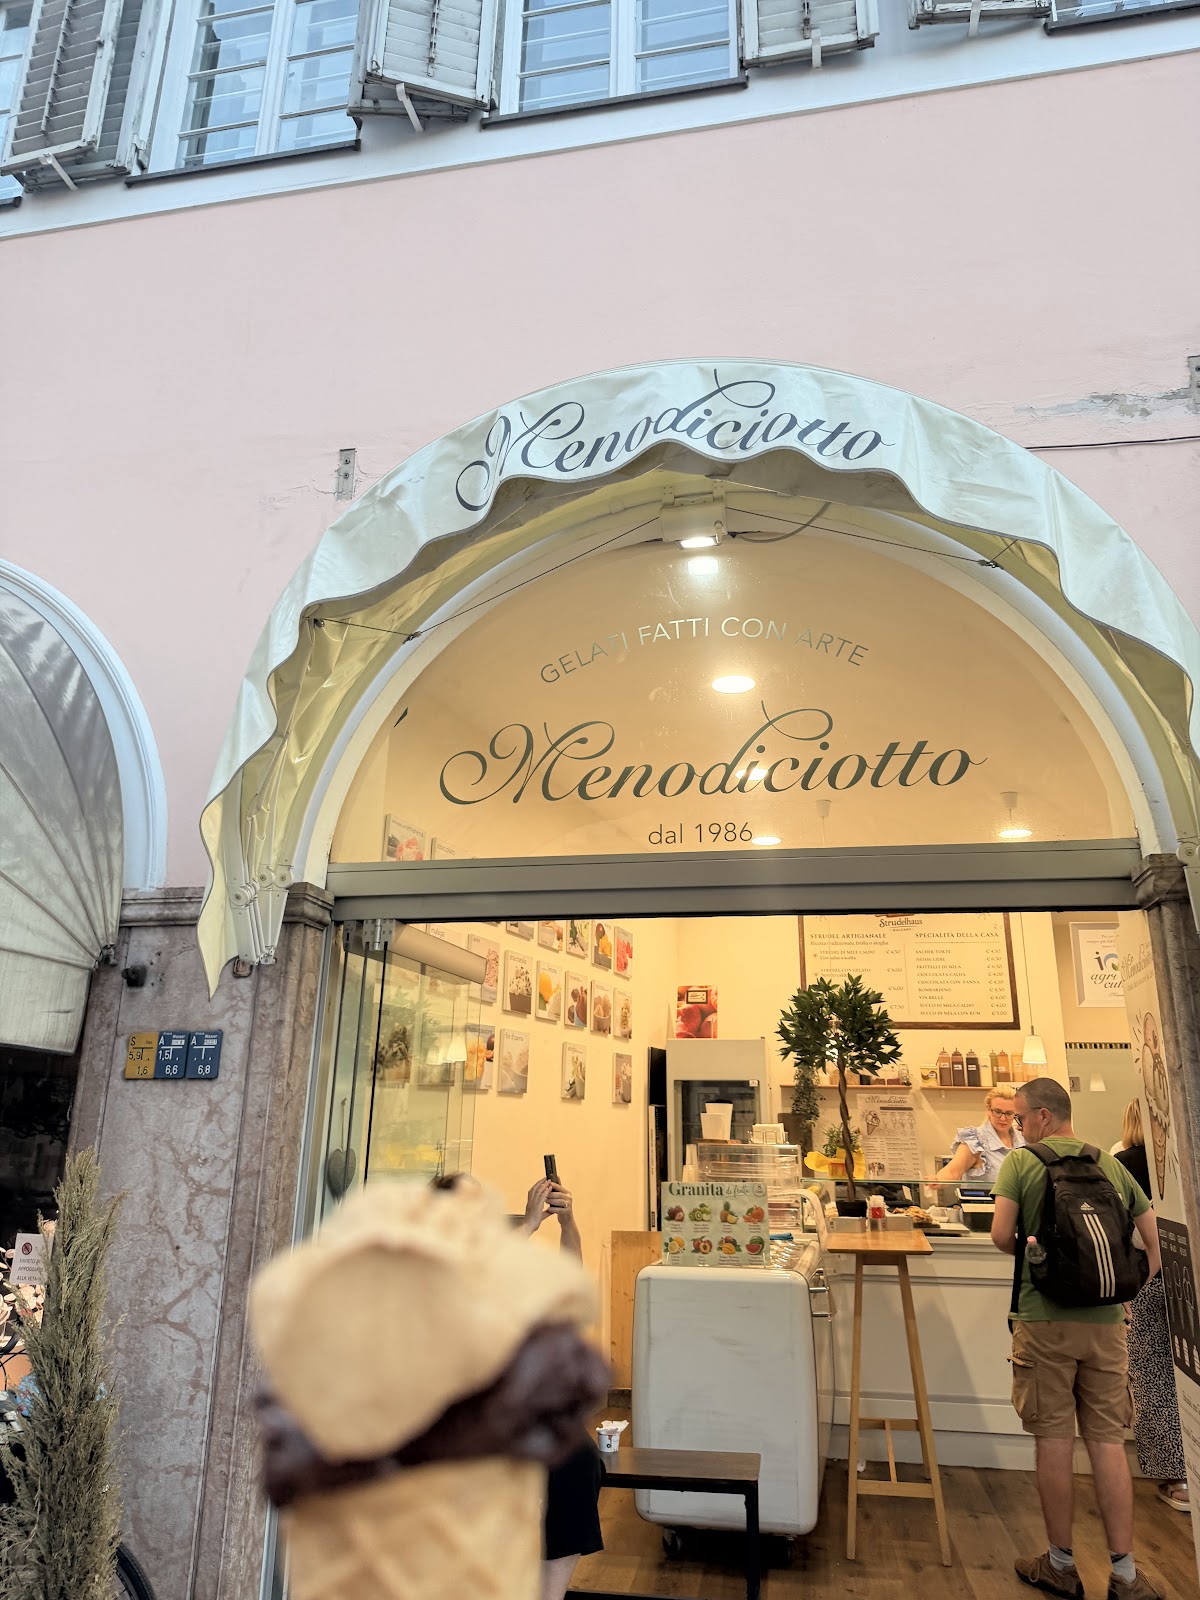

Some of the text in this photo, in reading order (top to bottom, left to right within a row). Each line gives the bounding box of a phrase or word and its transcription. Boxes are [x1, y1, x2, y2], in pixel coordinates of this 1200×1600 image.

[456, 369, 896, 511] Menodiciotto
[540, 617, 868, 683] GELATI FATTI CON ARTE
[439, 700, 988, 806] Menodiciotto
[648, 821, 753, 845] dal 1986
[879, 917, 923, 928] Strudelhaus
[1090, 973, 1117, 984] agri
[1104, 980, 1123, 988] cul
[131, 1037, 136, 1046] S
[159, 1036, 165, 1045] A
[191, 1036, 197, 1045] A
[129, 1052, 140, 1060] 5,9
[158, 1050, 170, 1061] 1,5
[137, 1066, 148, 1075] 1,6
[165, 1065, 178, 1075] 6,6
[198, 1065, 211, 1075] 6,8
[669, 1183, 723, 1196] Granita
